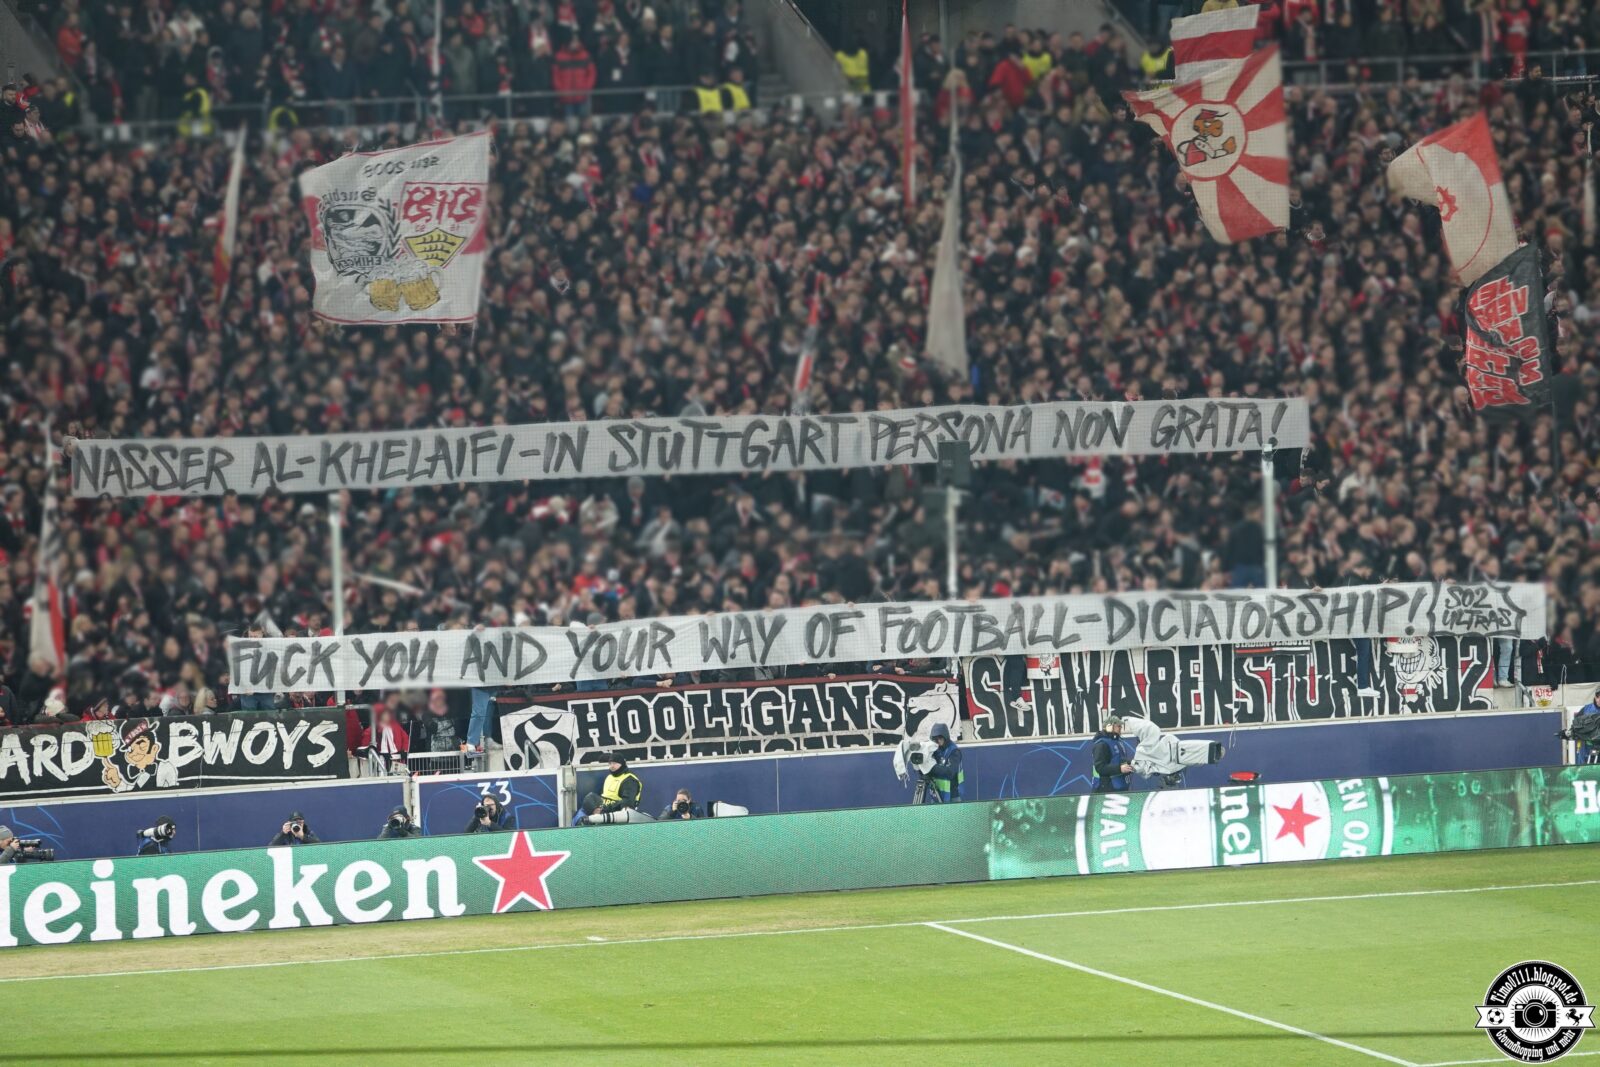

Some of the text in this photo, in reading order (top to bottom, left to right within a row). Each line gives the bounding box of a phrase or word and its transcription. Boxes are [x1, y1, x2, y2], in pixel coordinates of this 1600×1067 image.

[72, 443, 235, 495] NASSER
[608, 416, 858, 473] STUTTGART
[868, 405, 1033, 461] PERSONA
[1052, 404, 1136, 453] NON
[1150, 400, 1288, 449] GRATA!
[231, 640, 341, 689] FUCK
[350, 638, 439, 687] YOU
[459, 630, 548, 682] AND
[565, 620, 676, 682] YOUR
[699, 612, 788, 664] WAY
[805, 609, 865, 658] OF
[1442, 609, 1512, 631] ULTRAS
[168, 719, 339, 769] BWOYS
[568, 681, 906, 749] HOOLIGANS
[1099, 793, 1131, 870] MALT
[1572, 781, 1600, 814] H
[0, 847, 467, 948] eineken
